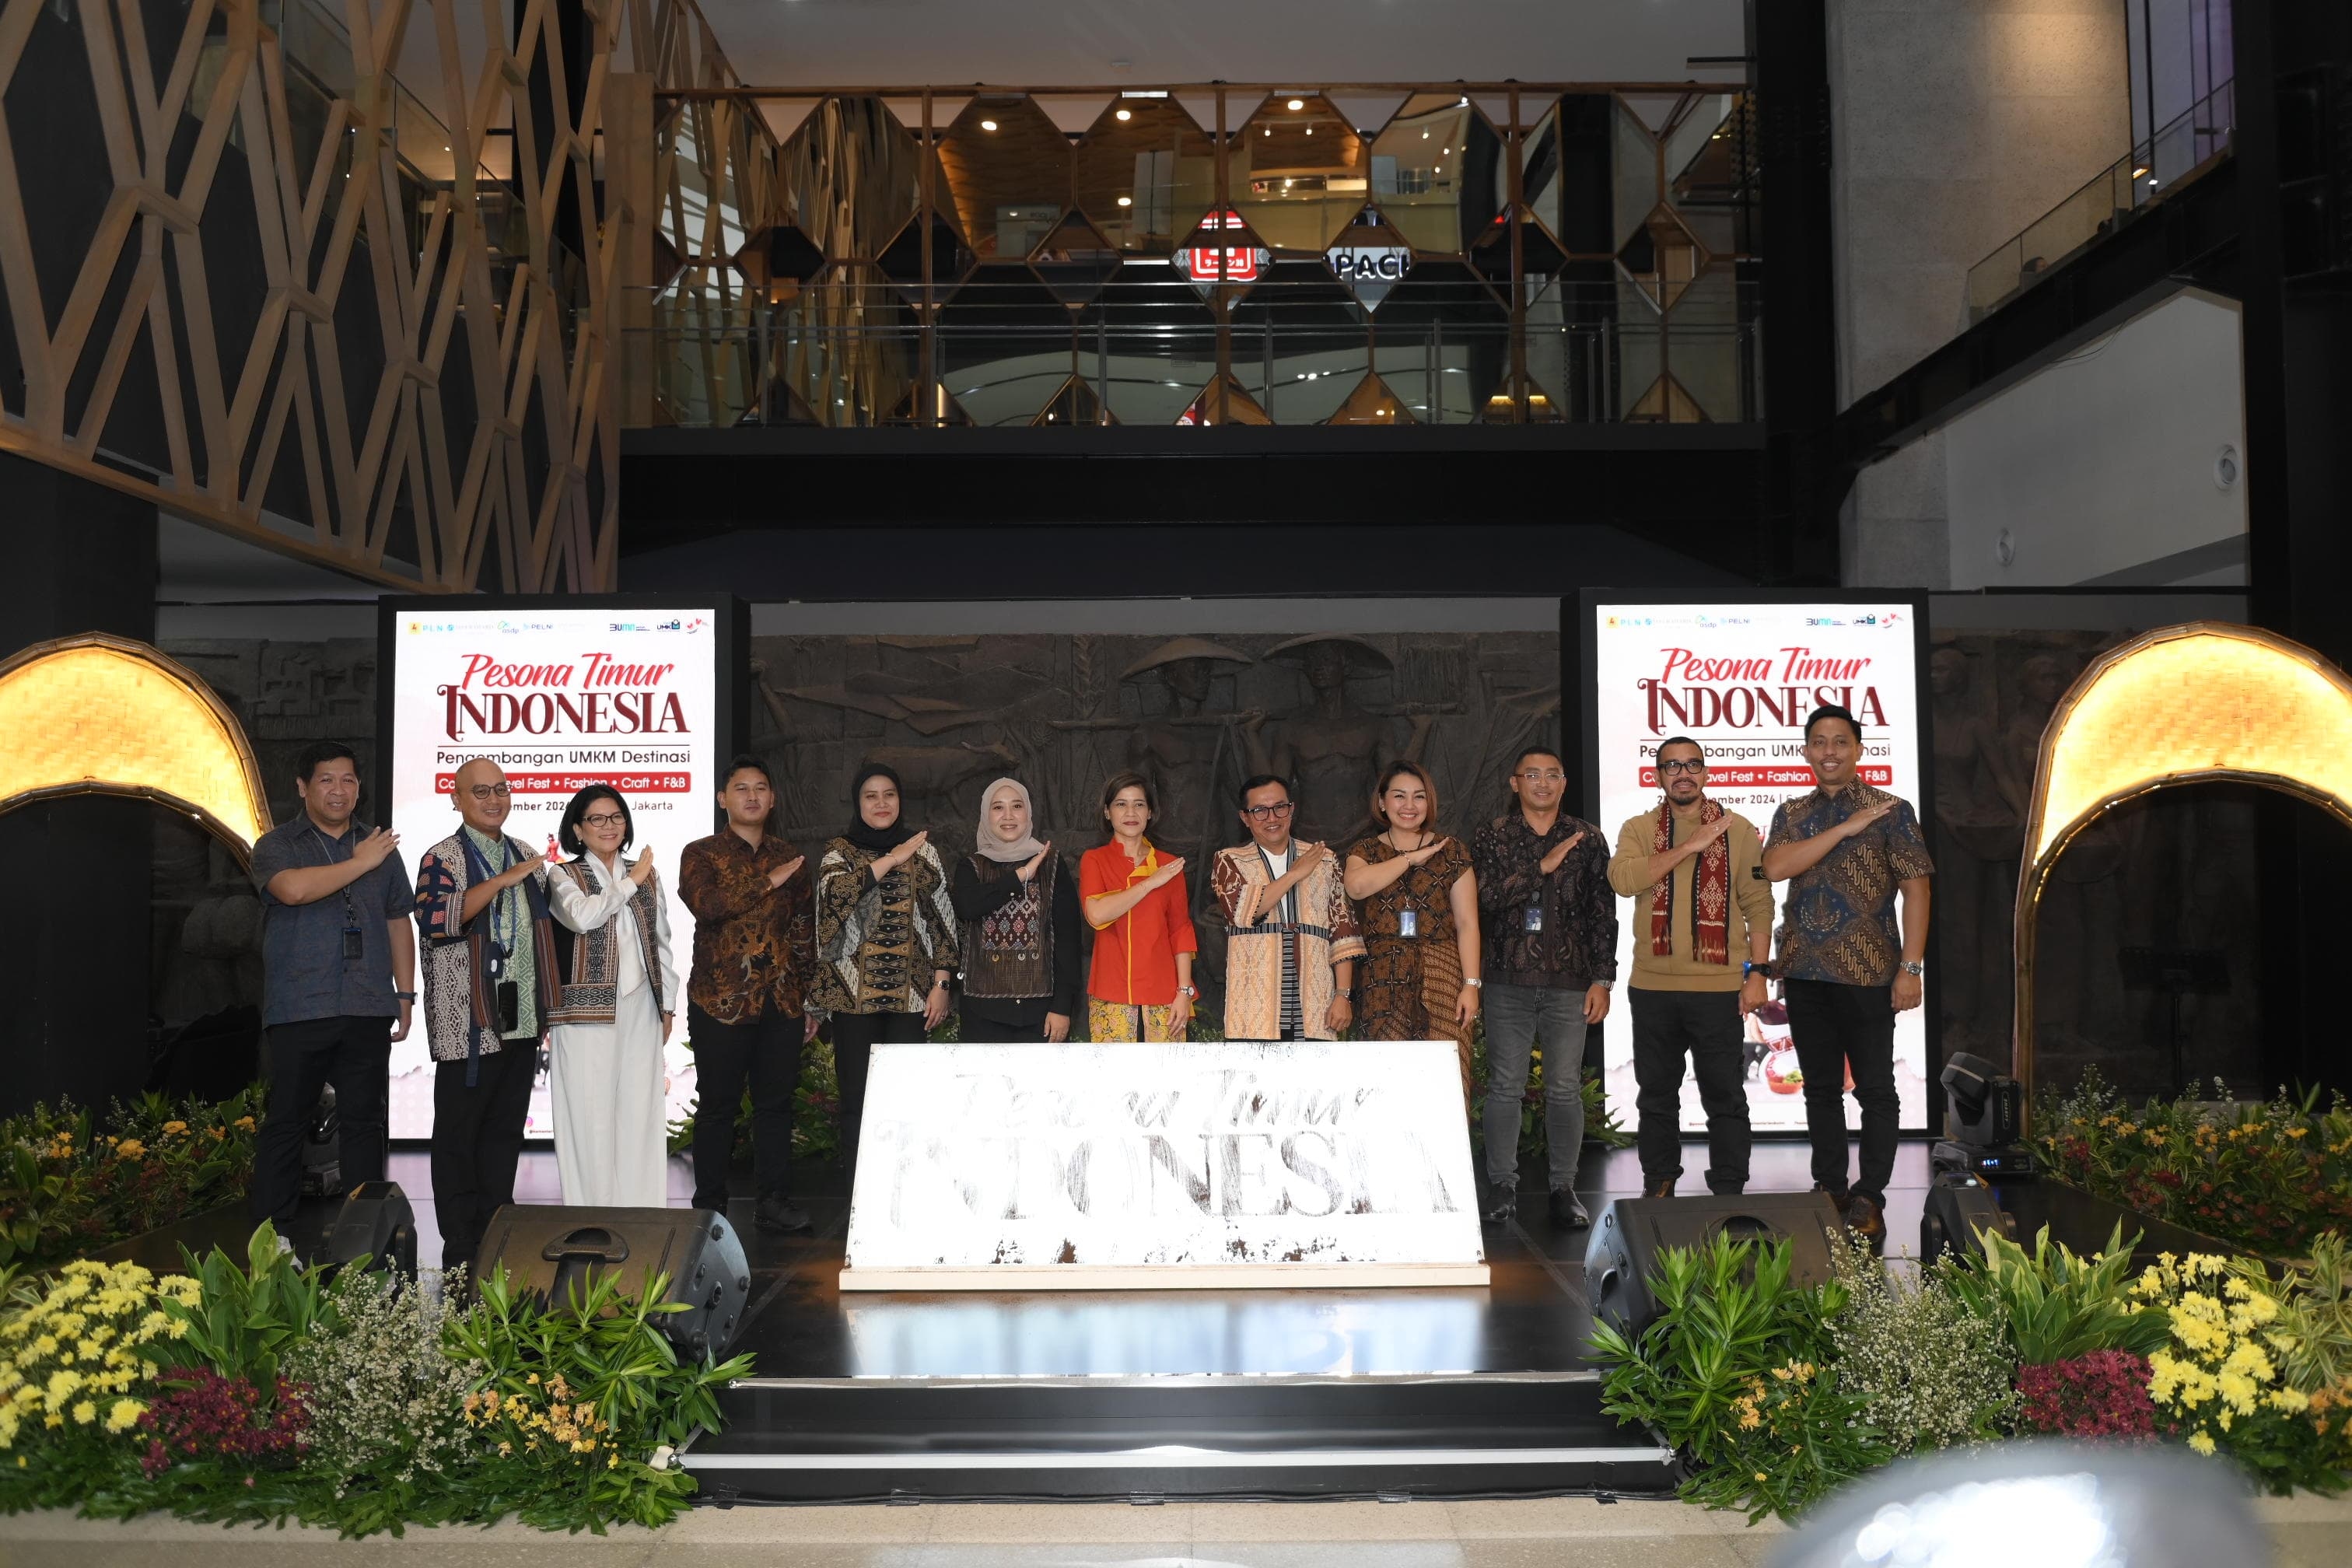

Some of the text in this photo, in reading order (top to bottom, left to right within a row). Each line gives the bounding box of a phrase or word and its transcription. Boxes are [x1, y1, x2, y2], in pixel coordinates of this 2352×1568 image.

[461, 652, 675, 691] Pesona Timur
[1660, 646, 1872, 685] Pesona Timur
[436, 684, 691, 743] INDONESIA
[436, 750, 691, 767] Penmbangan UMKM Destinasi
[1640, 744, 1804, 761] Pebangan UMK
[527, 778, 551, 789] Fest
[621, 777, 651, 789] Craft
[663, 777, 686, 788] F&B
[1731, 771, 1754, 782] Fest
[1766, 771, 1811, 782] Fashion
[1865, 770, 1888, 782] F&B
[632, 801, 674, 811] Jakarta
[1750, 794, 1775, 804] 2024
